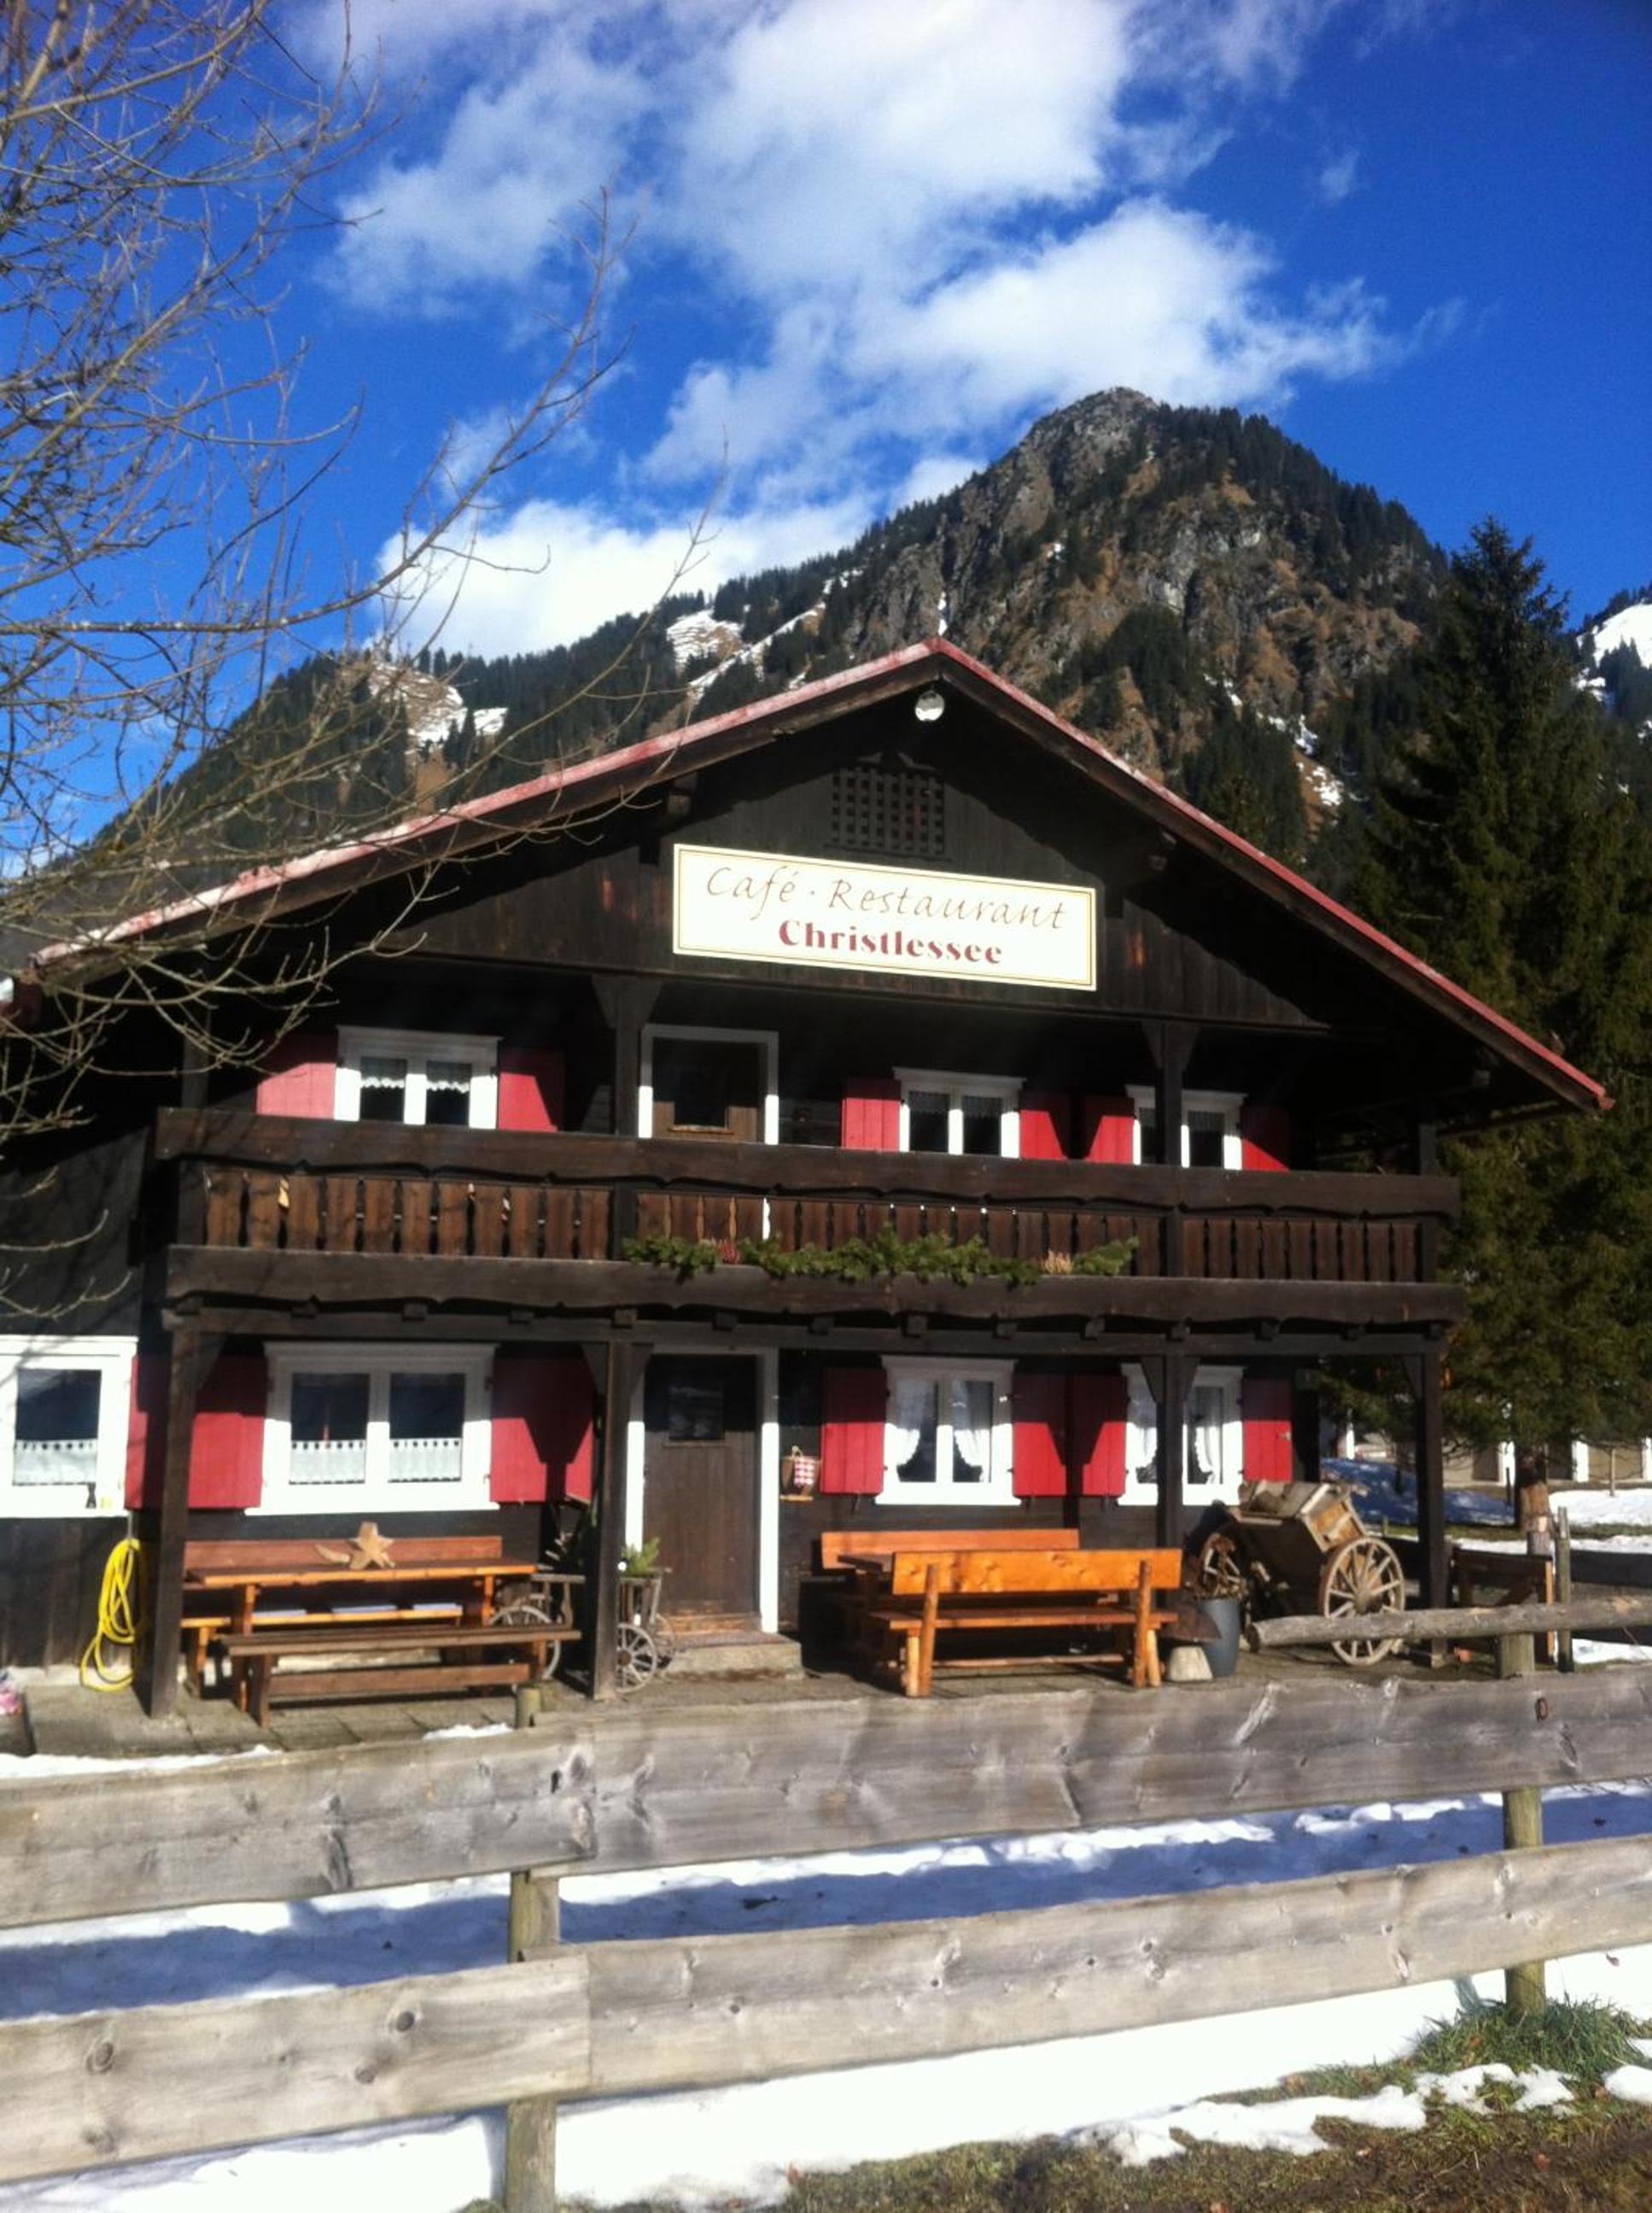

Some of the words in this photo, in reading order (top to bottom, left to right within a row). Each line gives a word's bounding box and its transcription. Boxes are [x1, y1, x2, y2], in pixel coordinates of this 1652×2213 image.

[706, 865, 798, 921] Café
[828, 878, 1068, 930] Restaurant
[778, 919, 1003, 965] Christlessee
